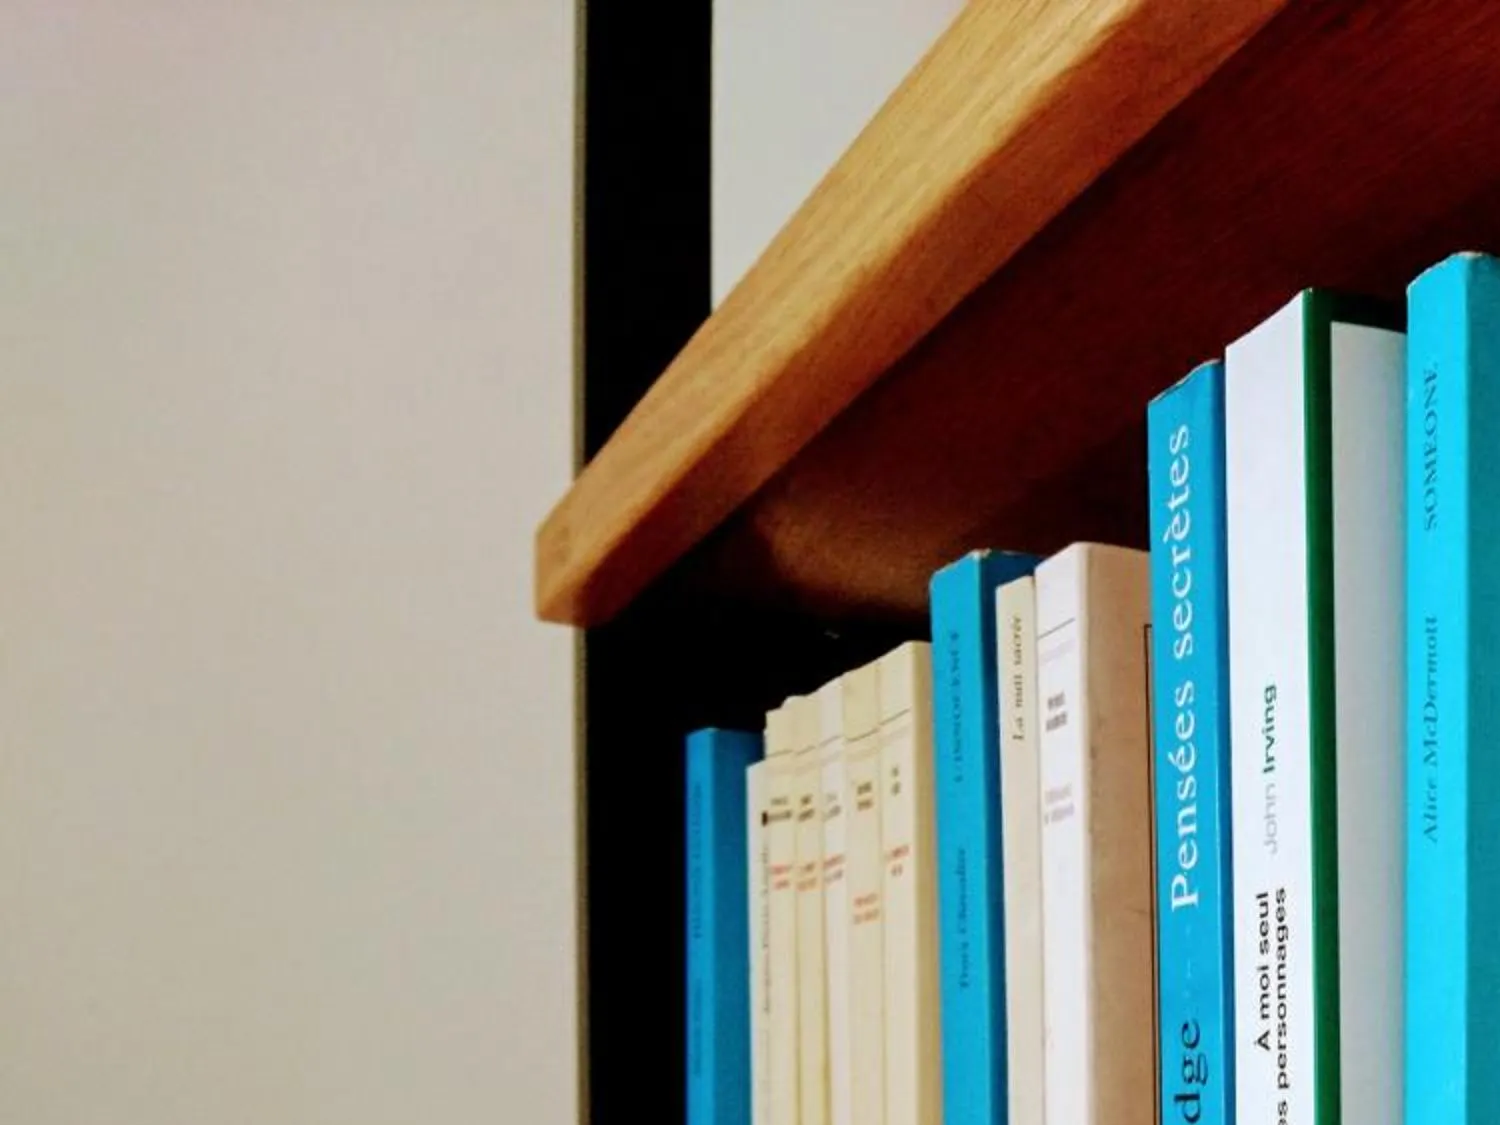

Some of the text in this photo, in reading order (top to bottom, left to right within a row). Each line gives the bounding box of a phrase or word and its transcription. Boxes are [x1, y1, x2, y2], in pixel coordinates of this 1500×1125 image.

[1423, 360, 1439, 533] SOMEONE
[1162, 424, 1199, 912] Pensées secrètes
[1422, 615, 1440, 844] Alice McDermott
[1262, 684, 1279, 856] John Irving
[1255, 891, 1271, 948] seul
[1256, 966, 1271, 1020] moi
[1275, 887, 1292, 1090] personnages
